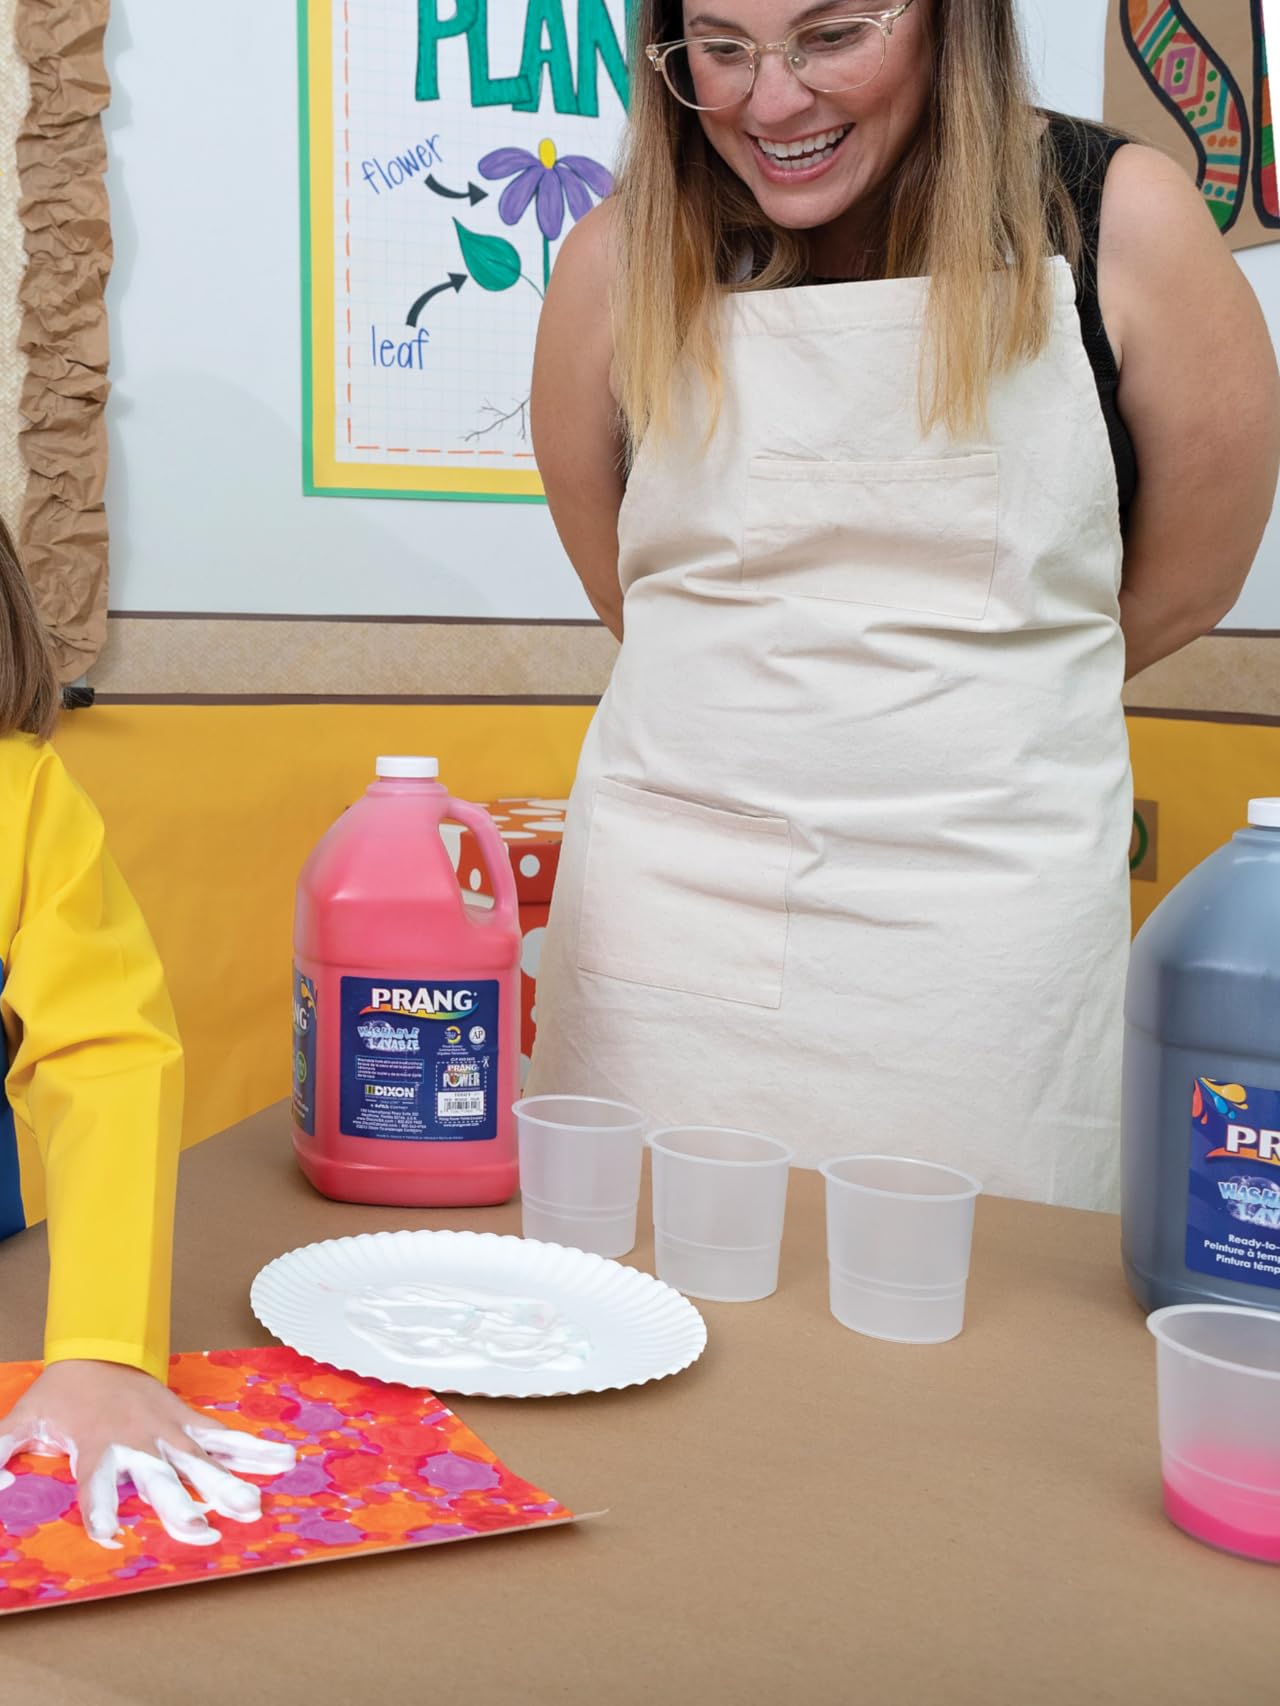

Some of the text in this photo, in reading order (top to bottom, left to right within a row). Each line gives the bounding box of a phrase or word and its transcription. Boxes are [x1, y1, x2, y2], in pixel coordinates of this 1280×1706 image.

[362, 134, 443, 194] flower
[372, 325, 430, 370] leaf
[371, 987, 473, 1014] PRANG
[357, 1025, 420, 1040] WASHABLE
[366, 1038, 420, 1051] LAVABLE
[447, 1063, 478, 1072] PRANG
[442, 1072, 481, 1087] POWER
[374, 1085, 414, 1098] DIXON
[1204, 1240, 1245, 1256] Peinture
[1247, 1248, 1255, 1257] à
[1228, 1234, 1280, 1250] Ready-to-
[1216, 1253, 1251, 1268] Pintura
